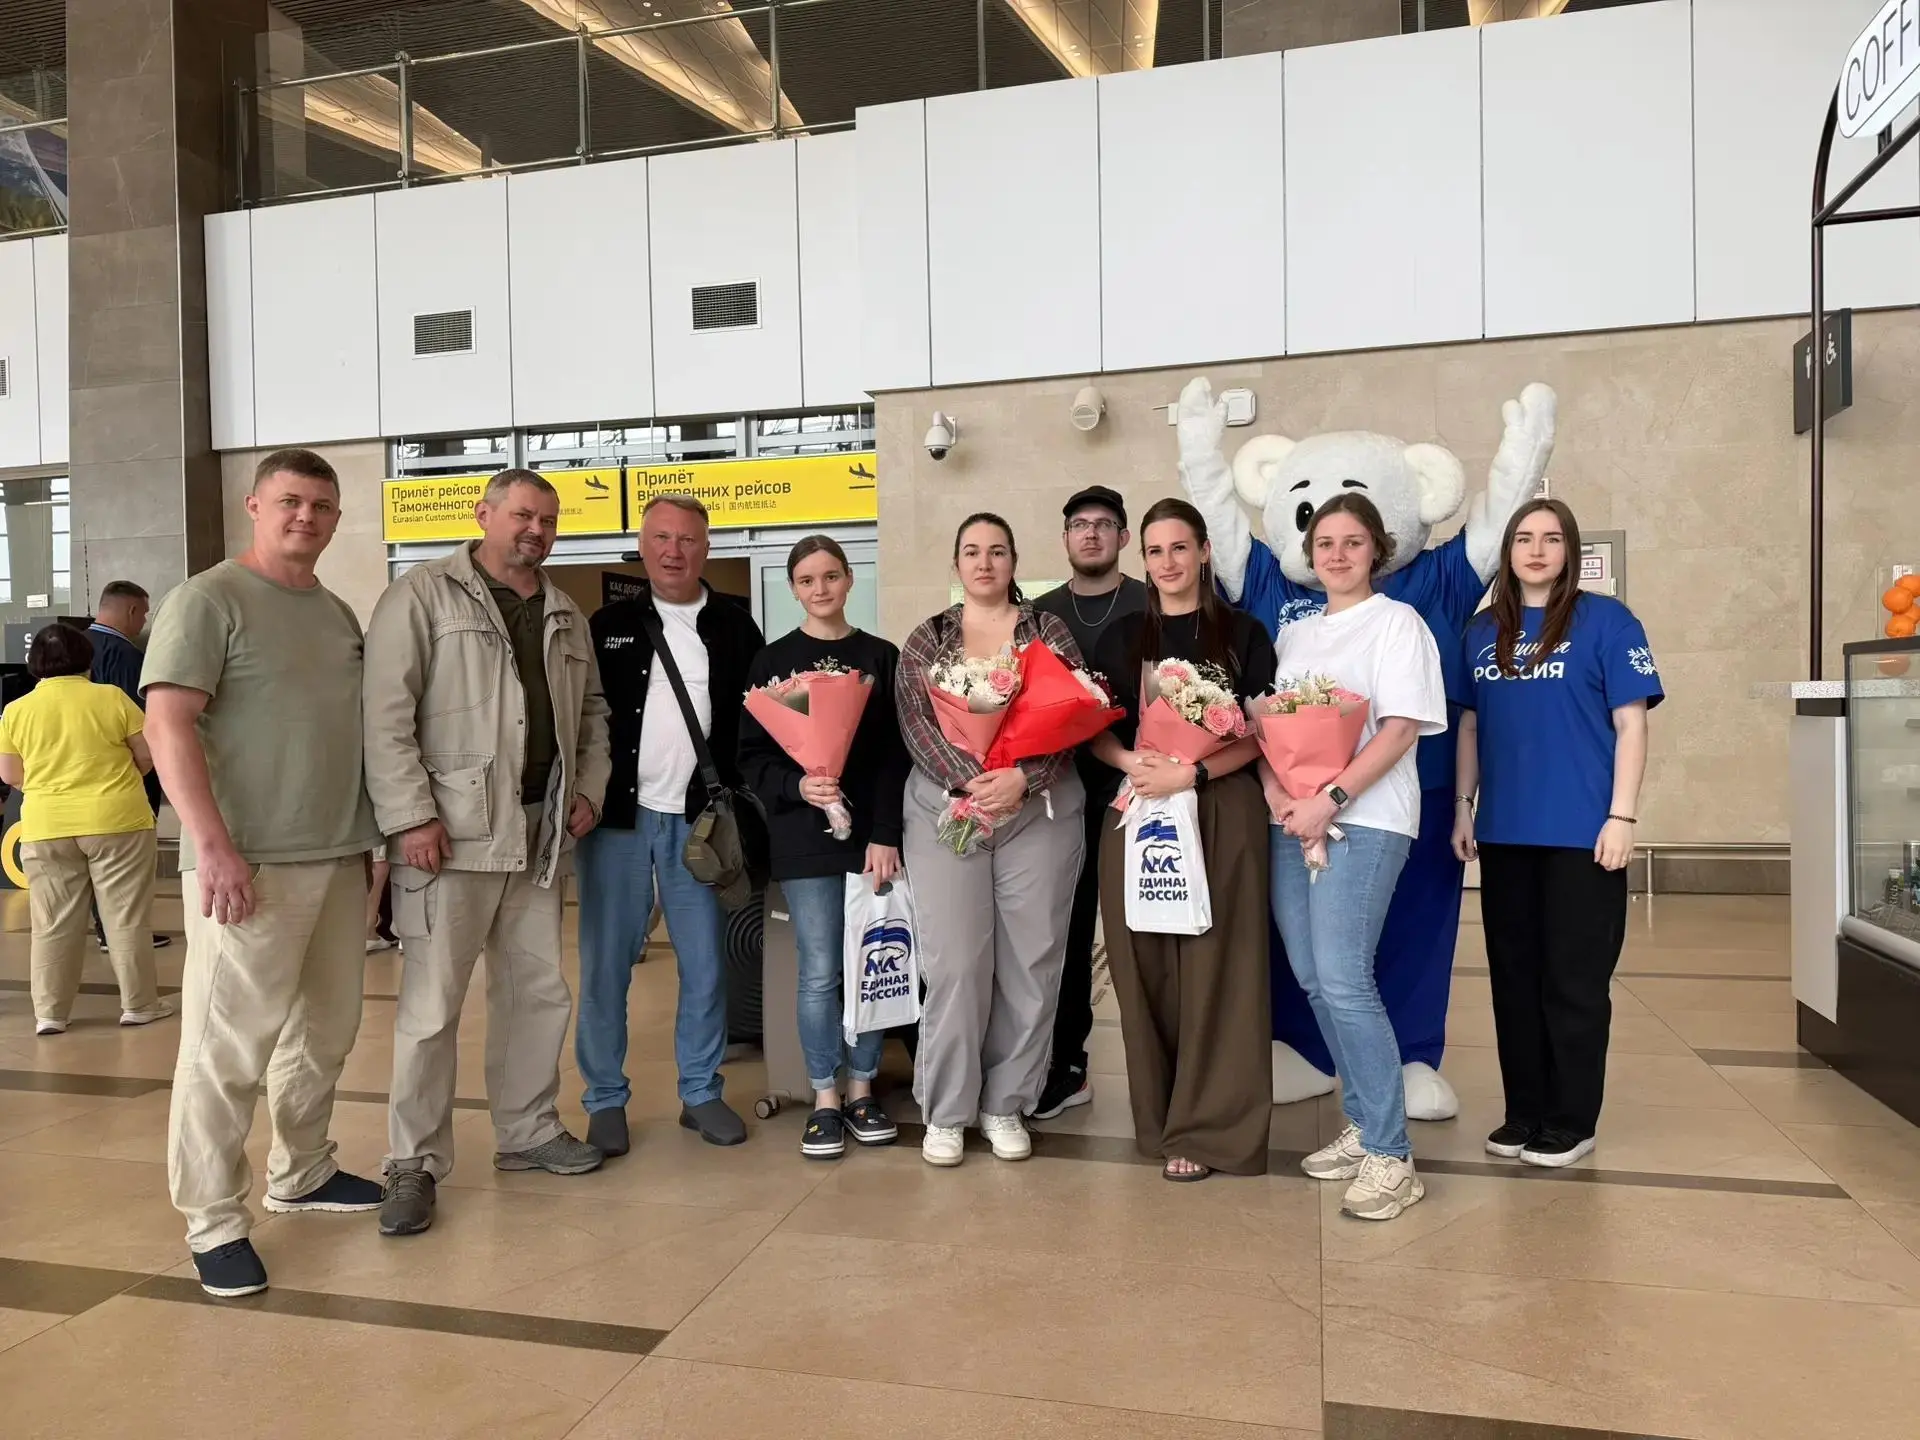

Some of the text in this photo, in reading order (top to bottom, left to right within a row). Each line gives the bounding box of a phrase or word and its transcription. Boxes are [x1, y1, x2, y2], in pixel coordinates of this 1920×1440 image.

[1846, 0, 1920, 120] COFF
[637, 469, 694, 489] Прилёт
[391, 484, 481, 501] Прилёт рейсов
[735, 480, 791, 500] рейсов
[391, 500, 475, 513] Таможенного
[392, 512, 475, 524] Eurasian Customs Unio
[1139, 890, 1189, 901] РОССИЯ
[861, 973, 909, 992] ЕДИНАЯ
[861, 985, 910, 1003] РОССИЯ
